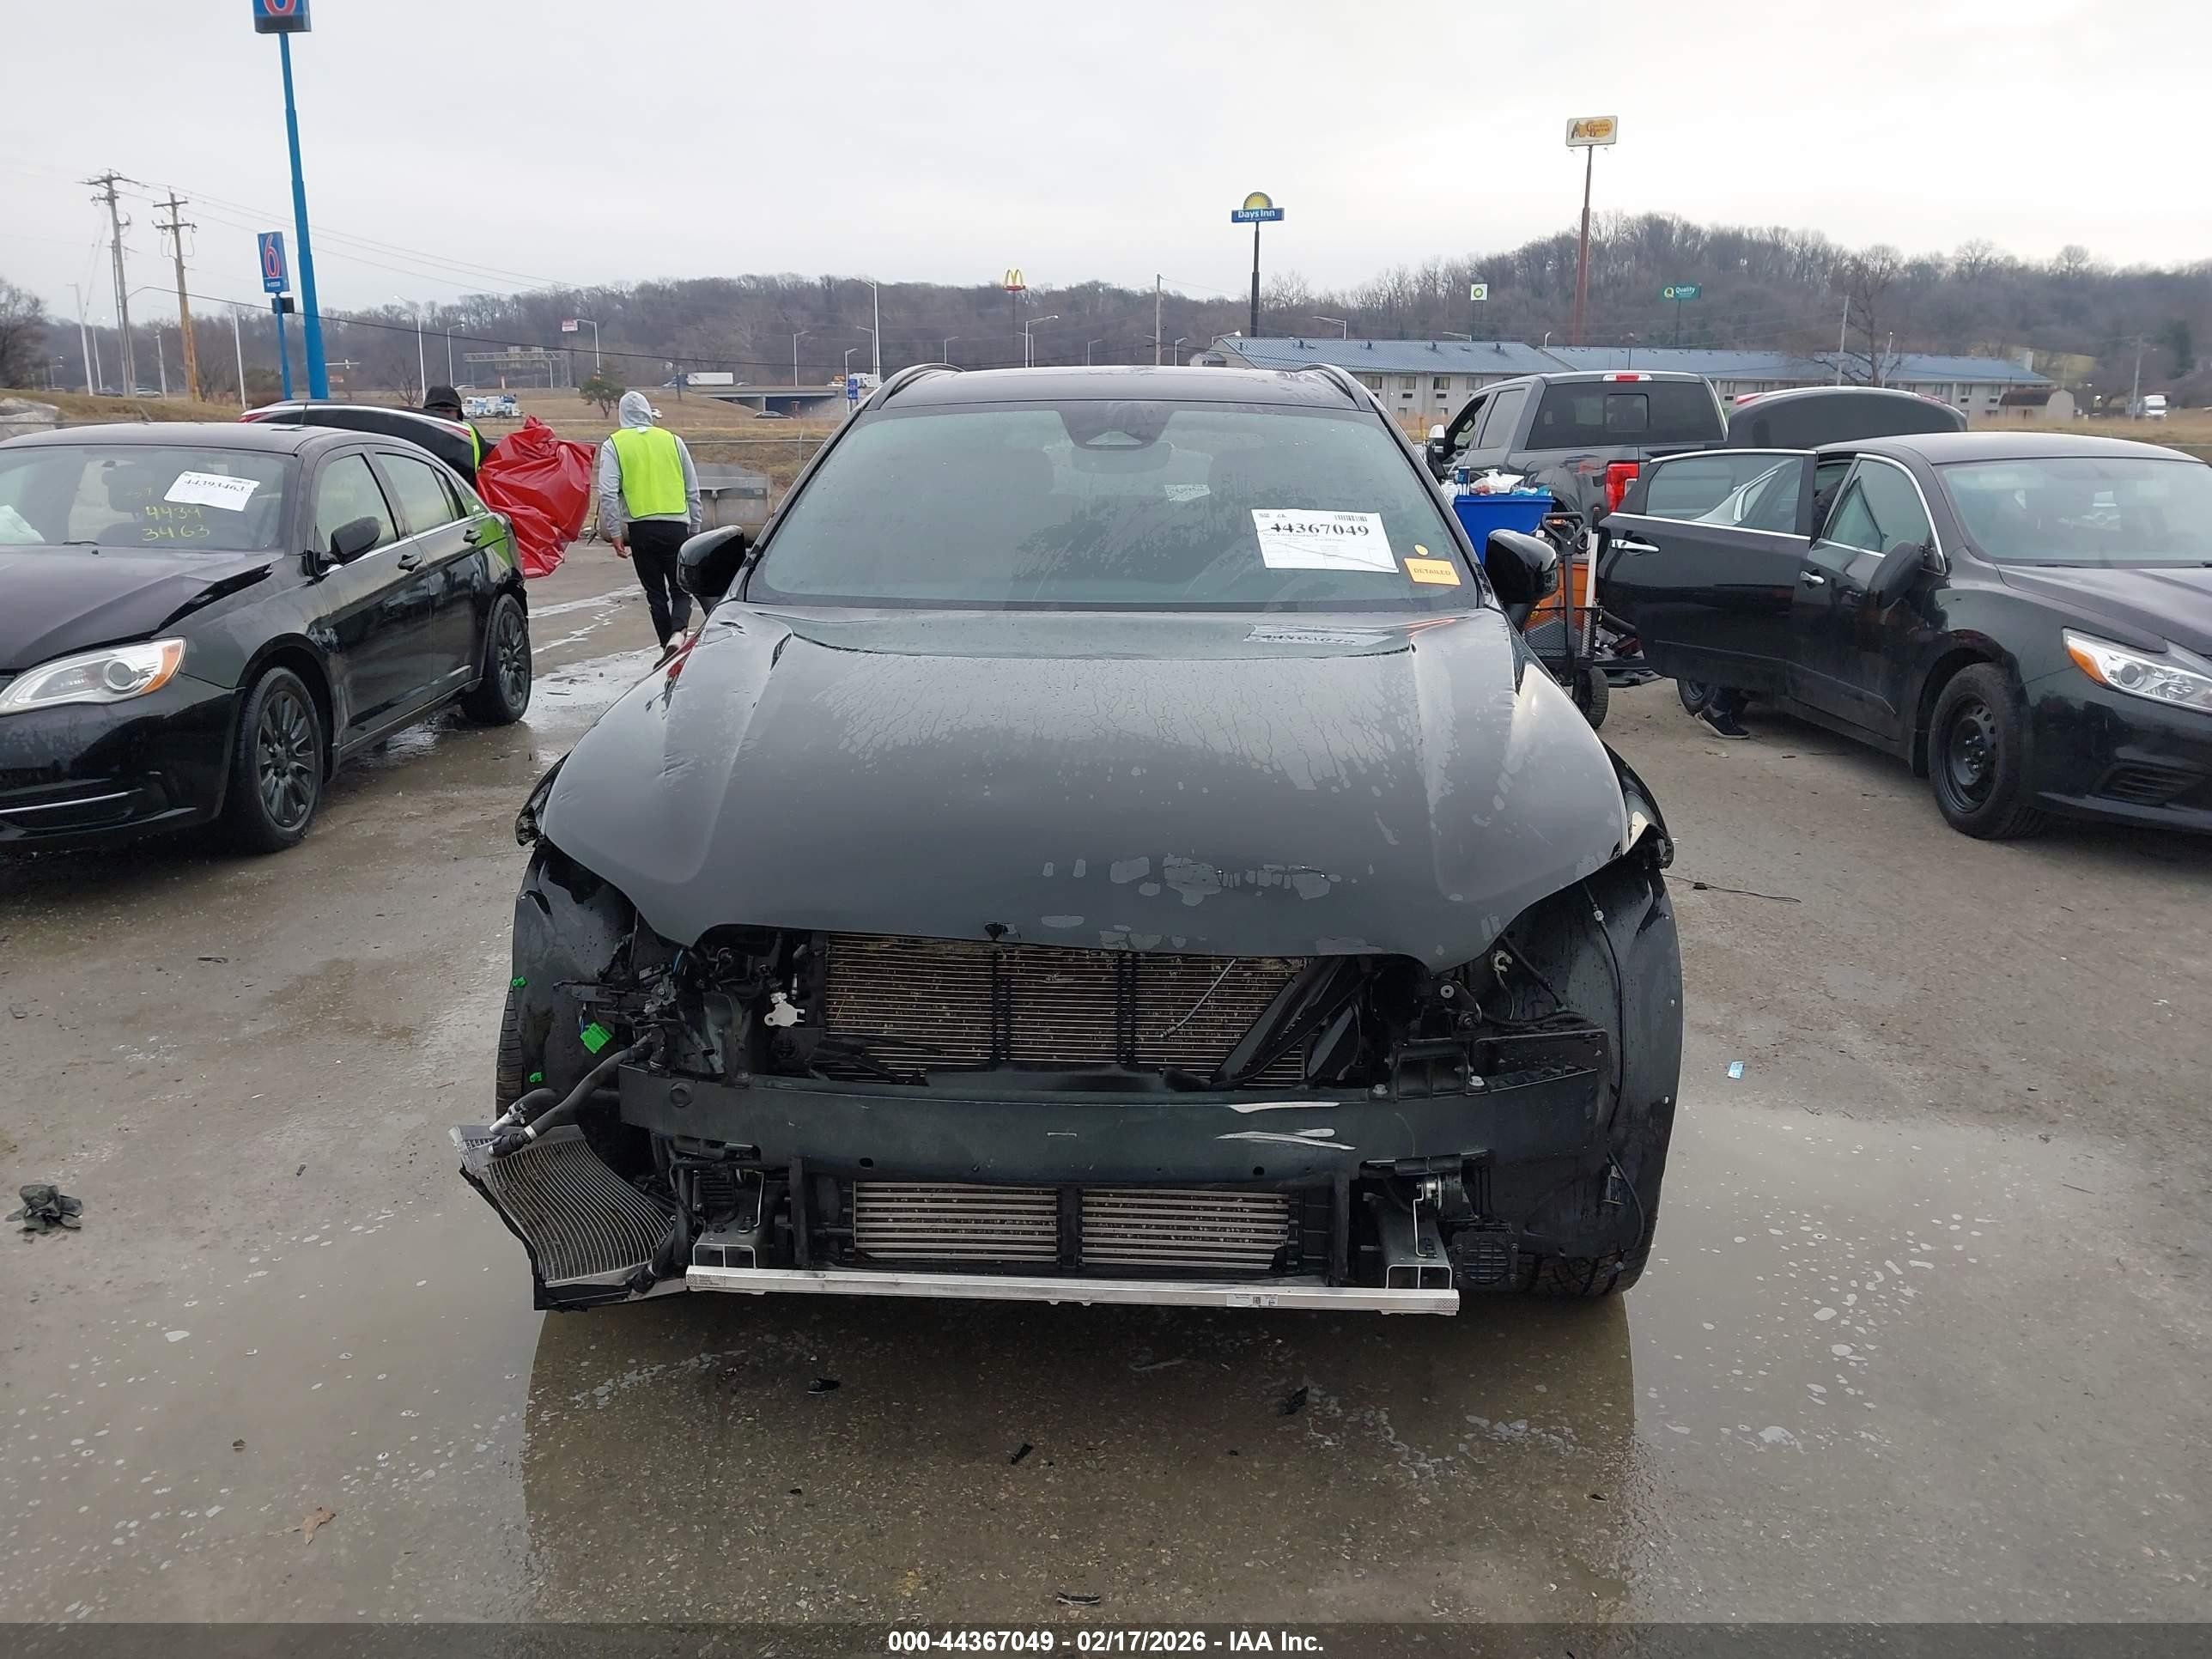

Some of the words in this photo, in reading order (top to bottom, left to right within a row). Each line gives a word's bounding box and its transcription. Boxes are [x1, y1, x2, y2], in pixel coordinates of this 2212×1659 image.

[1237, 210, 1259, 219] Days
[1260, 209, 1275, 217] Inn
[264, 234, 280, 278] 6
[145, 505, 201, 520] 4439
[142, 524, 210, 541] 3463
[1270, 522, 1370, 537] 44367049
[1413, 568, 1451, 576] DETAILED
